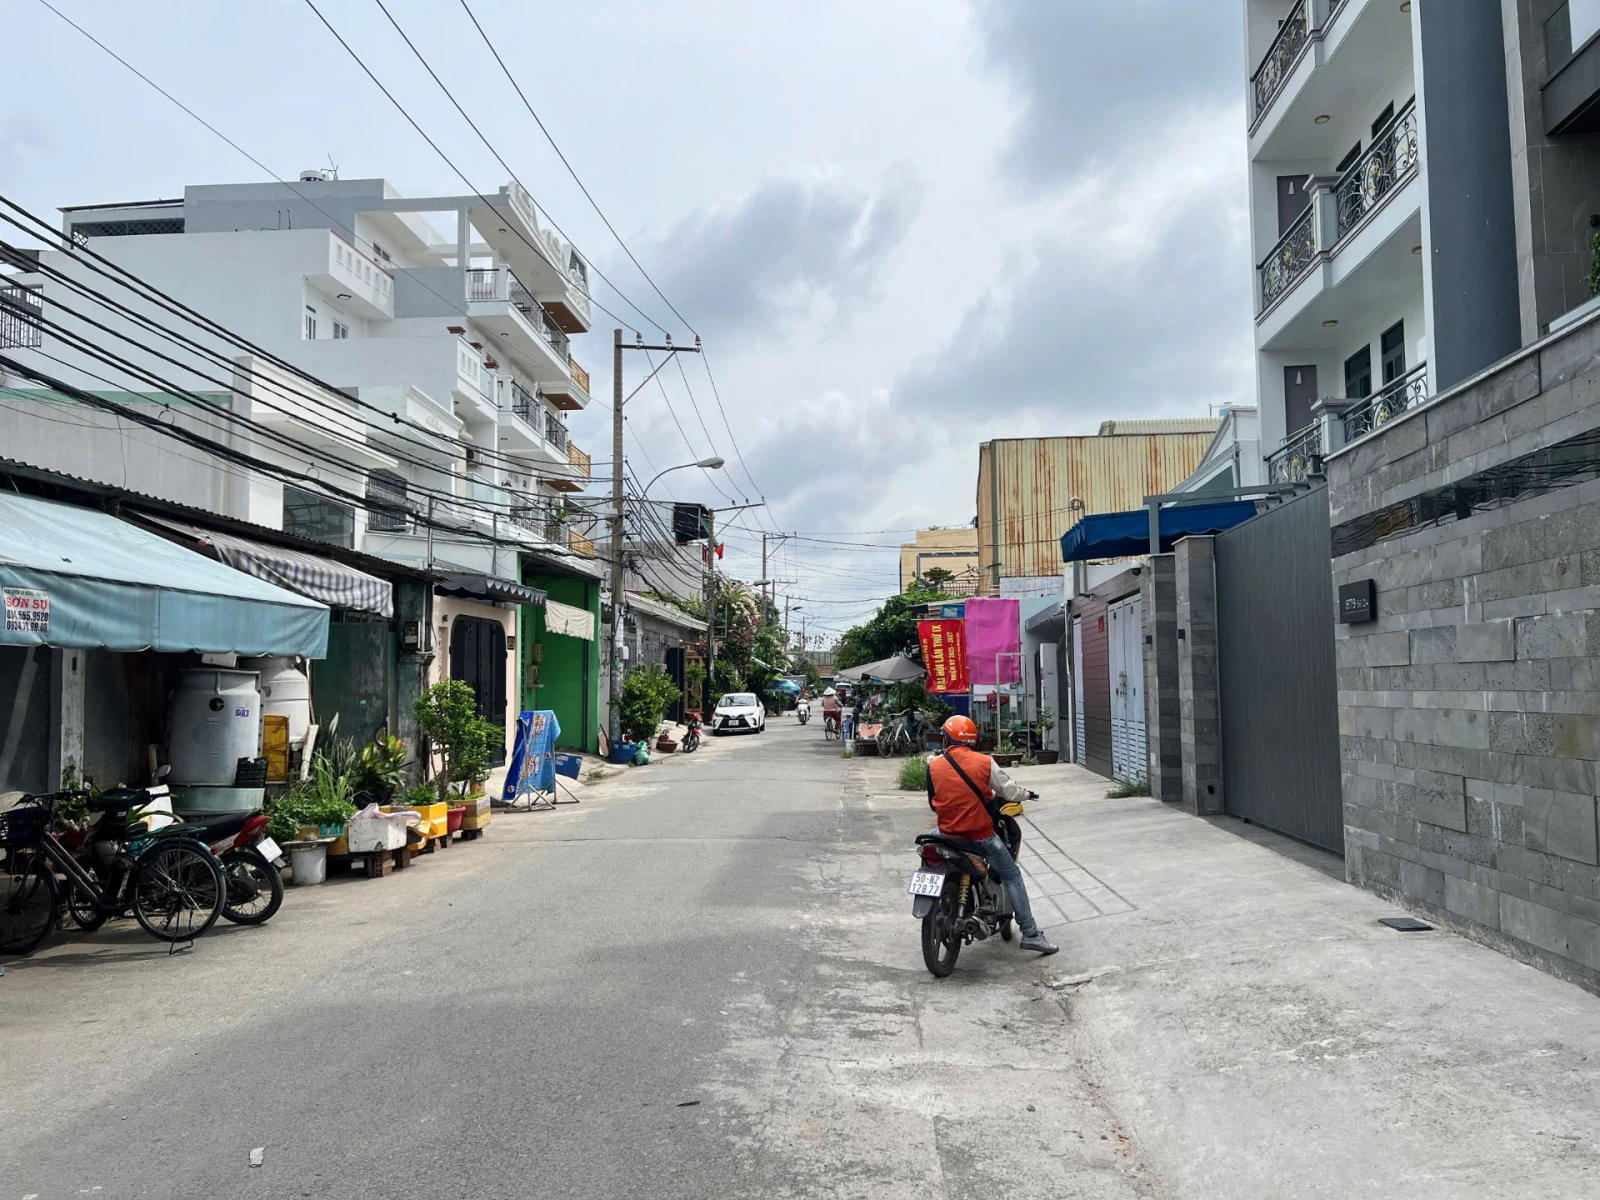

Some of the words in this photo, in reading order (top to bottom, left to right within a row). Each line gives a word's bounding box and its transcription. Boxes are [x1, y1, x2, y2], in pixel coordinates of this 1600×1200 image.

[6, 596, 30, 608] SƠN
[931, 624, 942, 632] IX
[931, 634, 943, 648] THỨ
[933, 664, 947, 676] HỘI
[936, 677, 948, 690] ĐẠI
[912, 883, 940, 895] 128.77
